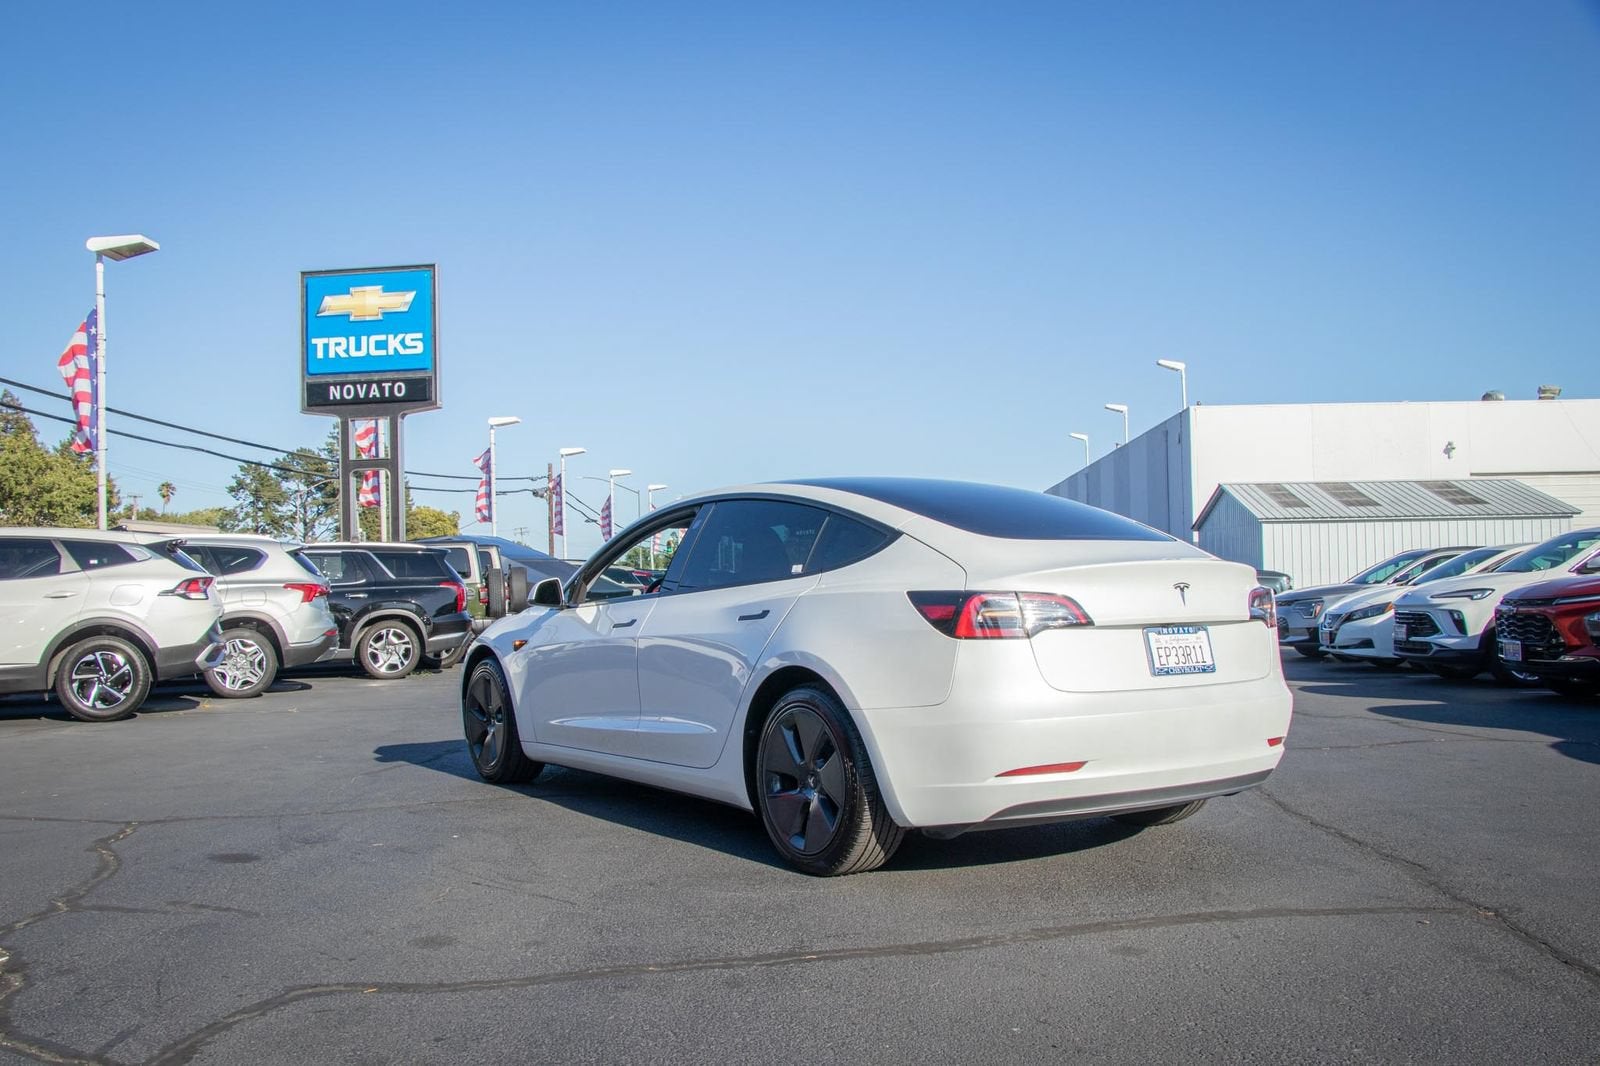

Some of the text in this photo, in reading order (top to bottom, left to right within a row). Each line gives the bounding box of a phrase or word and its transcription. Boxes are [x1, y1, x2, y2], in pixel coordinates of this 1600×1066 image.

[311, 332, 424, 359] TRUCKS
[329, 382, 406, 400] NOVATO
[1156, 645, 1207, 666] EP33R11
